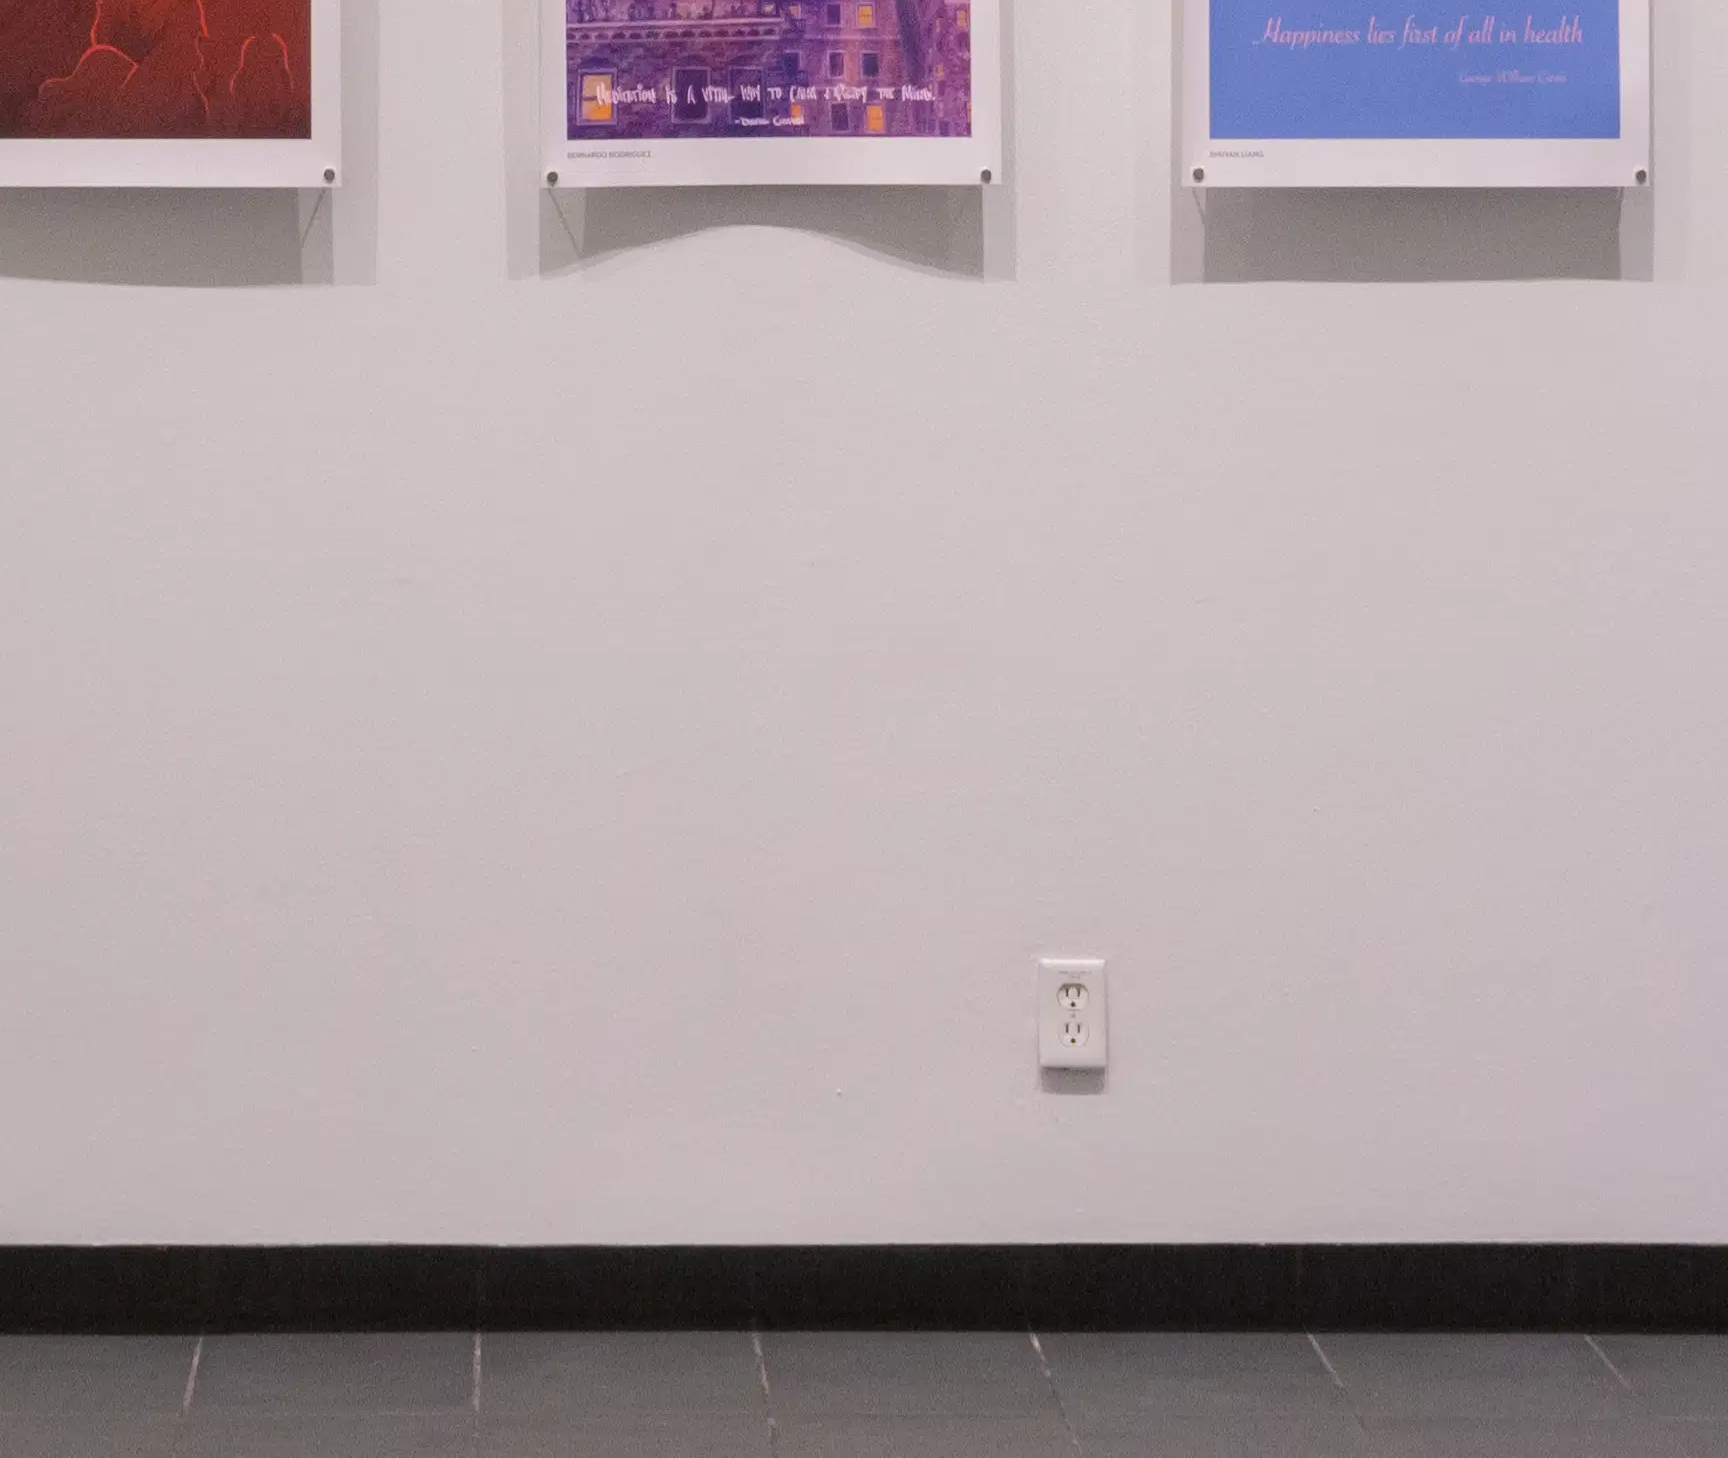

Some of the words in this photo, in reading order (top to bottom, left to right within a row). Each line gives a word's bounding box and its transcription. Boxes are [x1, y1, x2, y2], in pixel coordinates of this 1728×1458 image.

[1263, 15, 1361, 51] Happiness
[1397, 14, 1439, 51] first
[1443, 14, 1469, 51] of
[1468, 15, 1496, 44] all
[1499, 21, 1517, 44] in
[1524, 14, 1583, 45] health
